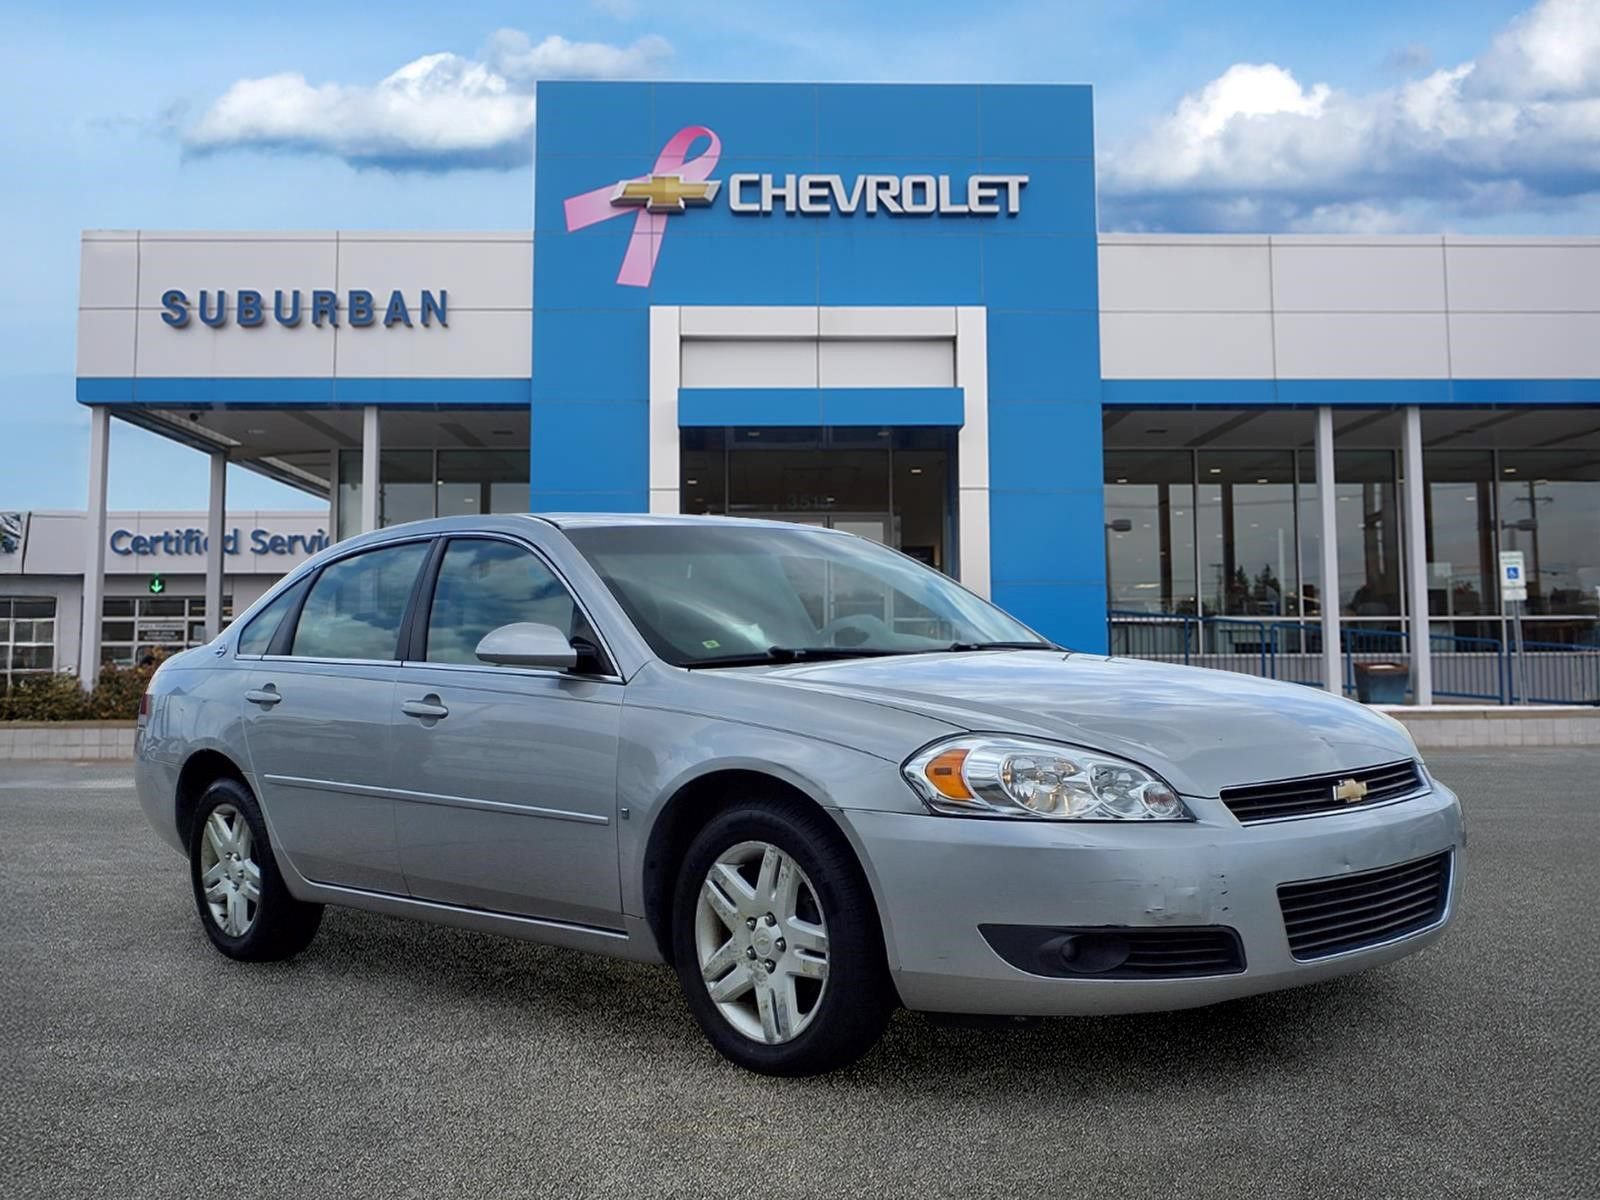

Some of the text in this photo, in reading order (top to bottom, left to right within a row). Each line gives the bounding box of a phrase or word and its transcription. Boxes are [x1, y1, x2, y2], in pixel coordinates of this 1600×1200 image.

[728, 172, 1029, 216] CHEVROLET
[160, 288, 450, 329] SUBURBAN
[110, 529, 240, 555] Certifid
